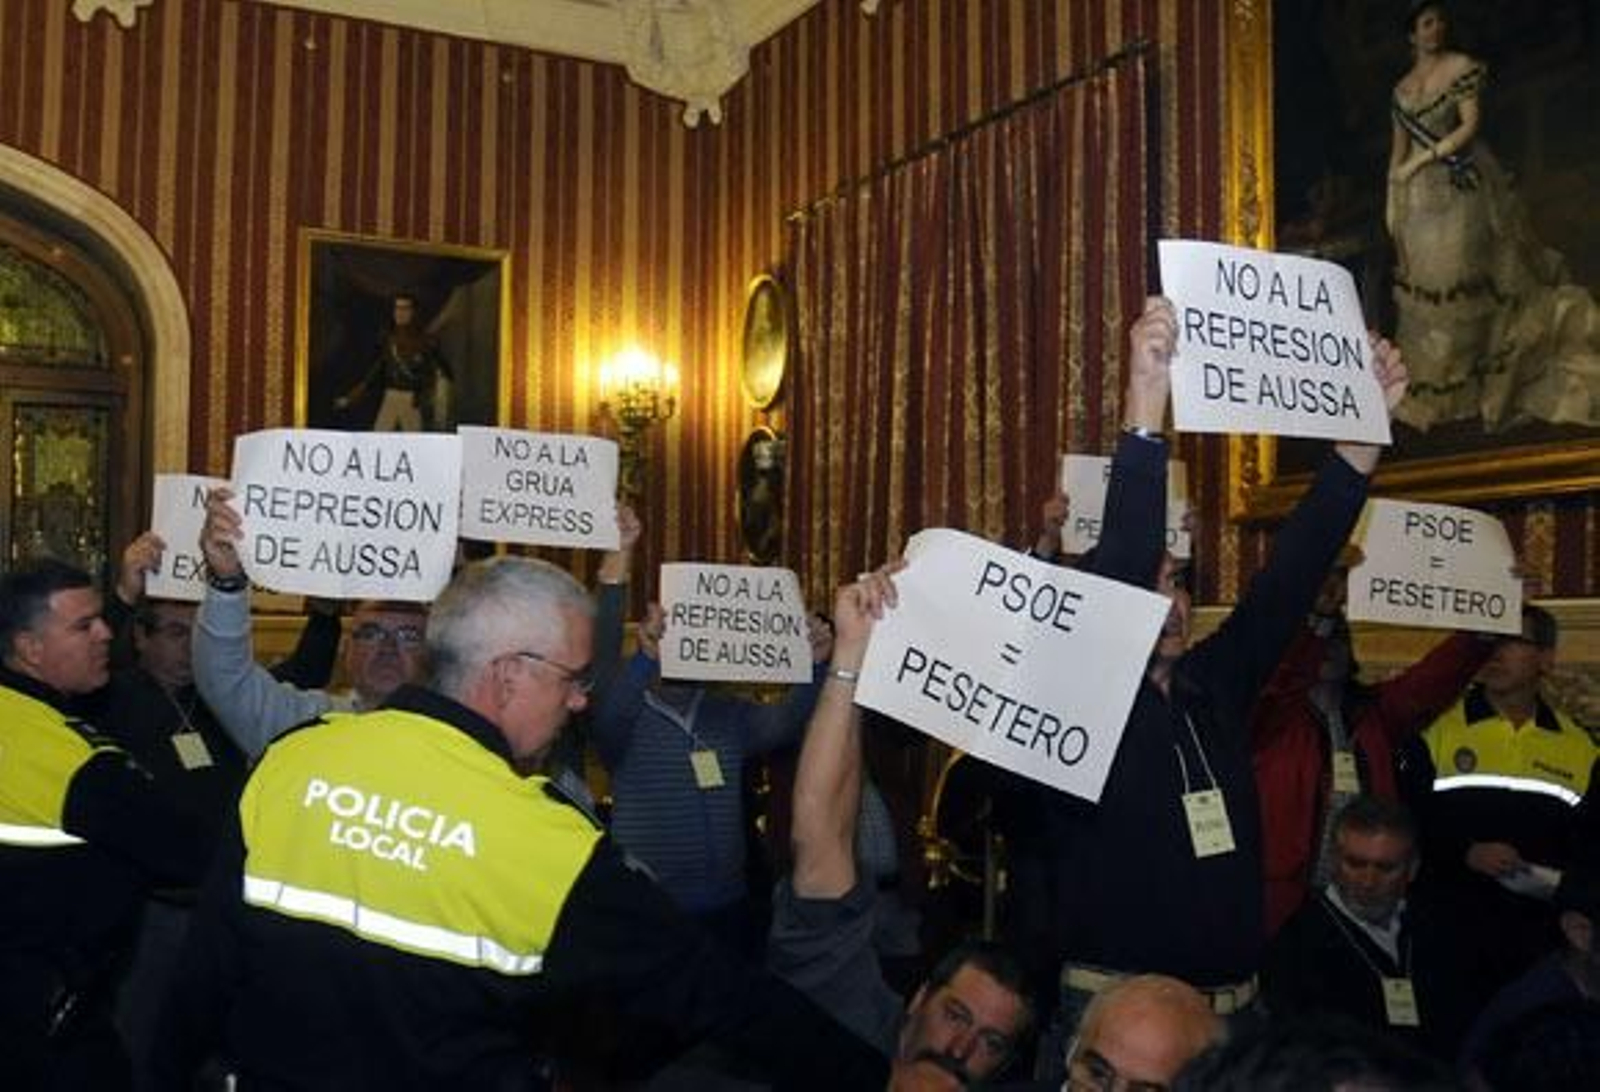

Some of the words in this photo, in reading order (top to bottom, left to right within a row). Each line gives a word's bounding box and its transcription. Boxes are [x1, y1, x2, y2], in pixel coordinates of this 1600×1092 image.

[1215, 258, 1260, 300] NO
[1268, 272, 1288, 307] A
[1298, 275, 1333, 315] LA
[1184, 307, 1364, 370] REPRESION
[1203, 363, 1247, 403] DE
[1258, 373, 1360, 419] AUSSA
[283, 440, 334, 477] NO
[343, 448, 364, 479] A
[374, 449, 413, 482] LA
[494, 437, 531, 460] NO
[537, 443, 553, 464] A
[561, 444, 589, 468] LA
[506, 470, 574, 498] GRUA
[244, 483, 443, 533] REPRESION
[480, 498, 593, 535] EXPRESS
[1405, 512, 1474, 544] PSOE
[255, 533, 302, 568] DE
[310, 541, 421, 580] AUSSA
[697, 572, 731, 597] NO
[735, 577, 750, 598] A
[757, 578, 783, 602] LA
[975, 561, 1083, 633] PSOE
[1369, 577, 1506, 620] PESETERO
[672, 602, 802, 637] REPRESION
[680, 638, 709, 662] DE
[717, 641, 791, 668] AUSSA
[897, 646, 1089, 766] PESETERO
[304, 778, 476, 857] POLICIA
[329, 820, 428, 871] LOCAL
